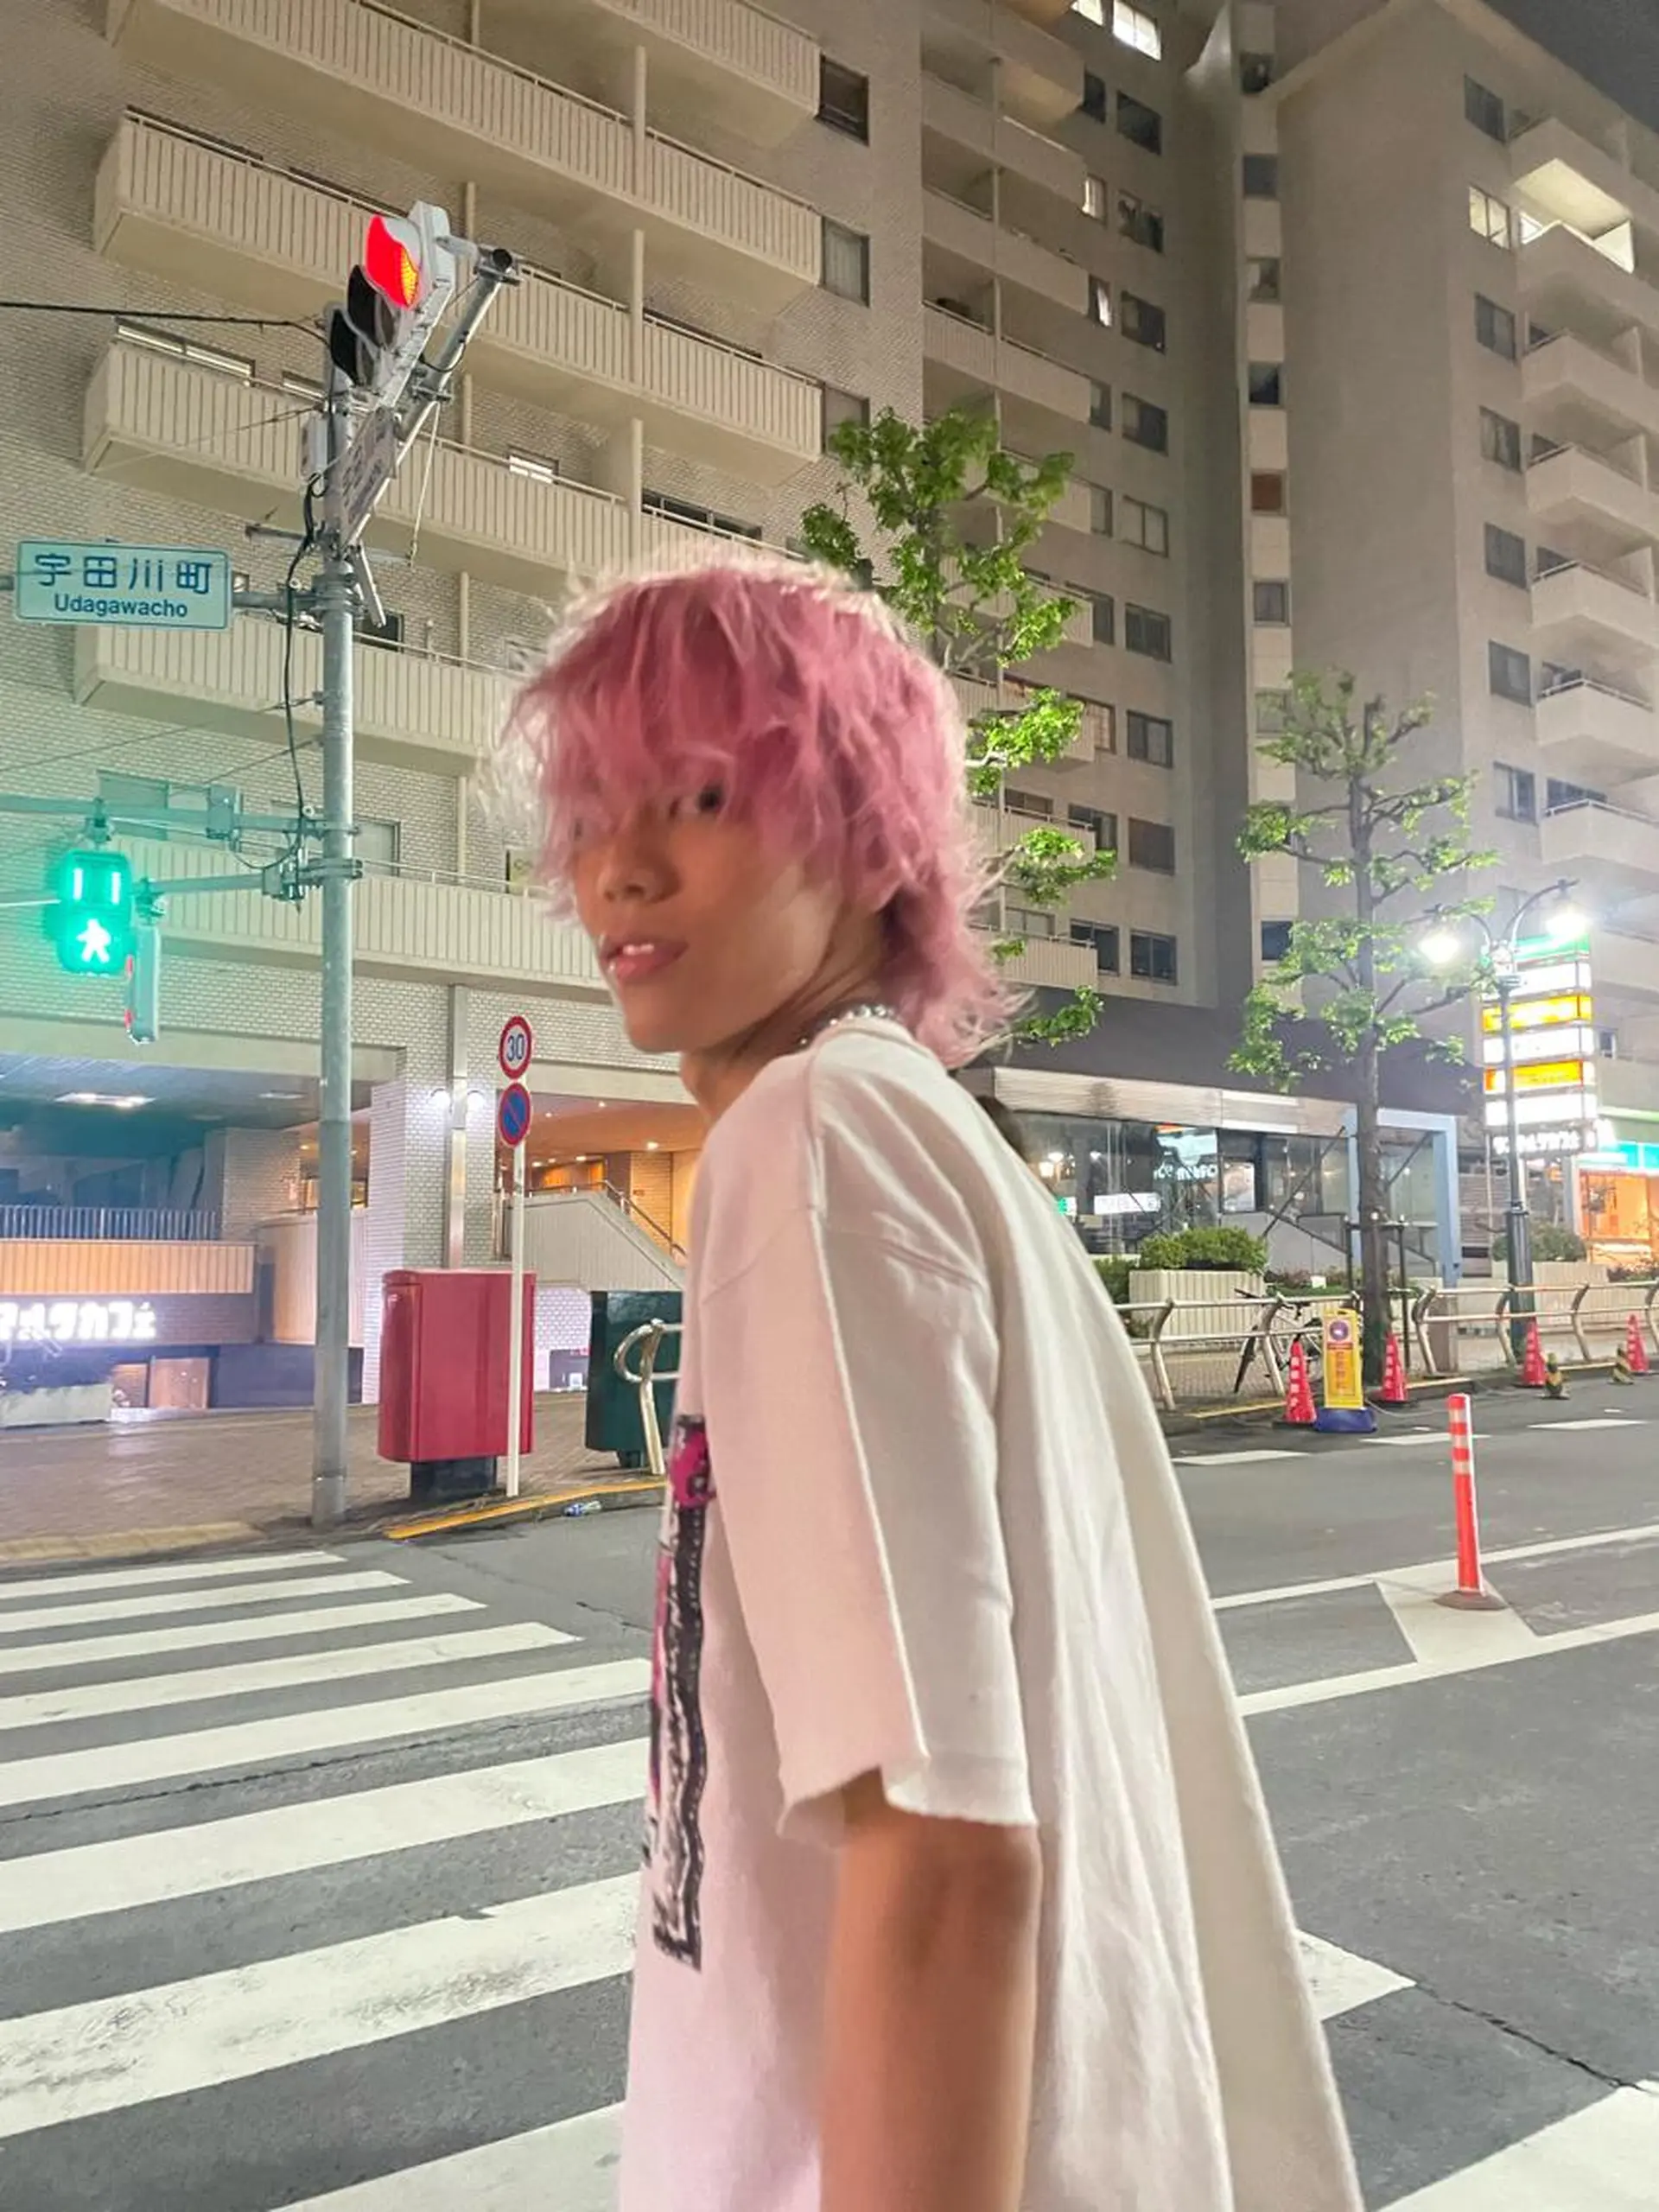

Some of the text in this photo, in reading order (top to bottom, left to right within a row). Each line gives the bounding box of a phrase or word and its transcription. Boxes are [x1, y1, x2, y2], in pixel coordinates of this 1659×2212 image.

[35, 554, 213, 594] 宇田川町
[54, 594, 188, 618] Udagawacho
[506, 1033, 525, 1062] 30
